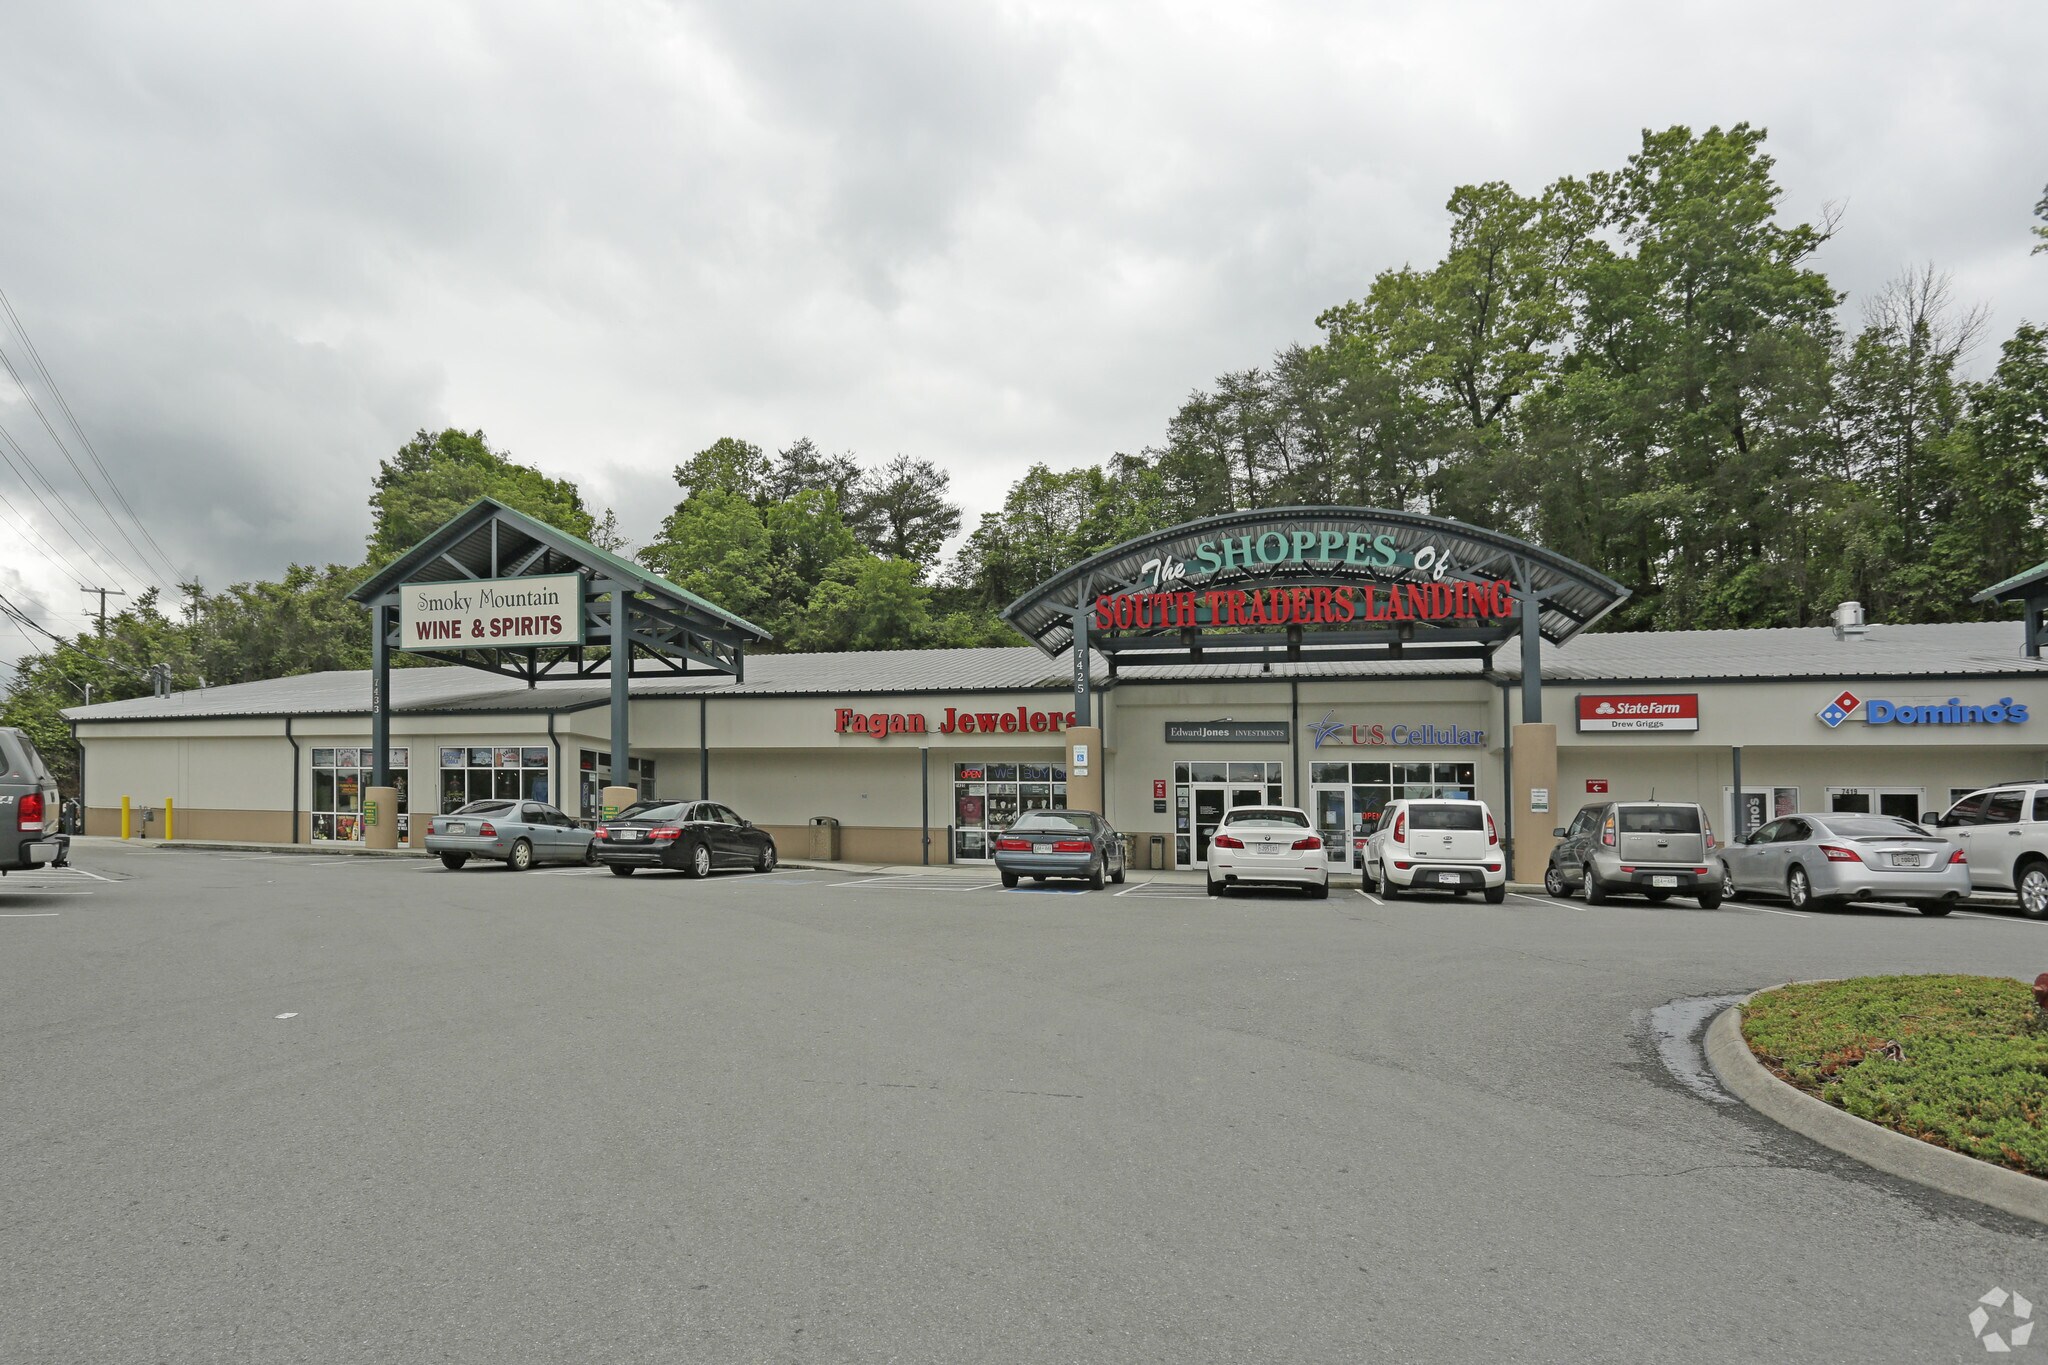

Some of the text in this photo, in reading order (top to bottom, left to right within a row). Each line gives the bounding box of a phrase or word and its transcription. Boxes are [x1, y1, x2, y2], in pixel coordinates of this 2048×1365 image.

[1142, 531, 1450, 587] The SHOPPES Of
[417, 586, 560, 614] Smoky Mountain
[1095, 580, 1513, 629] SOUTH TRADERS LANDING
[416, 614, 563, 640] WINE & SPIRITS
[1076, 649, 1085, 694] 7425
[834, 706, 1076, 740] Fagan Jewelers
[1866, 697, 2029, 724] Domino's
[1235, 729, 1285, 737] INVESTMENTS
[1350, 724, 1484, 746] U.S. Cellular
[1612, 720, 1664, 729] Drew Griggs
[961, 769, 983, 779] OPEN
[995, 768, 1016, 779] WE
[1023, 768, 1049, 779] BUY
